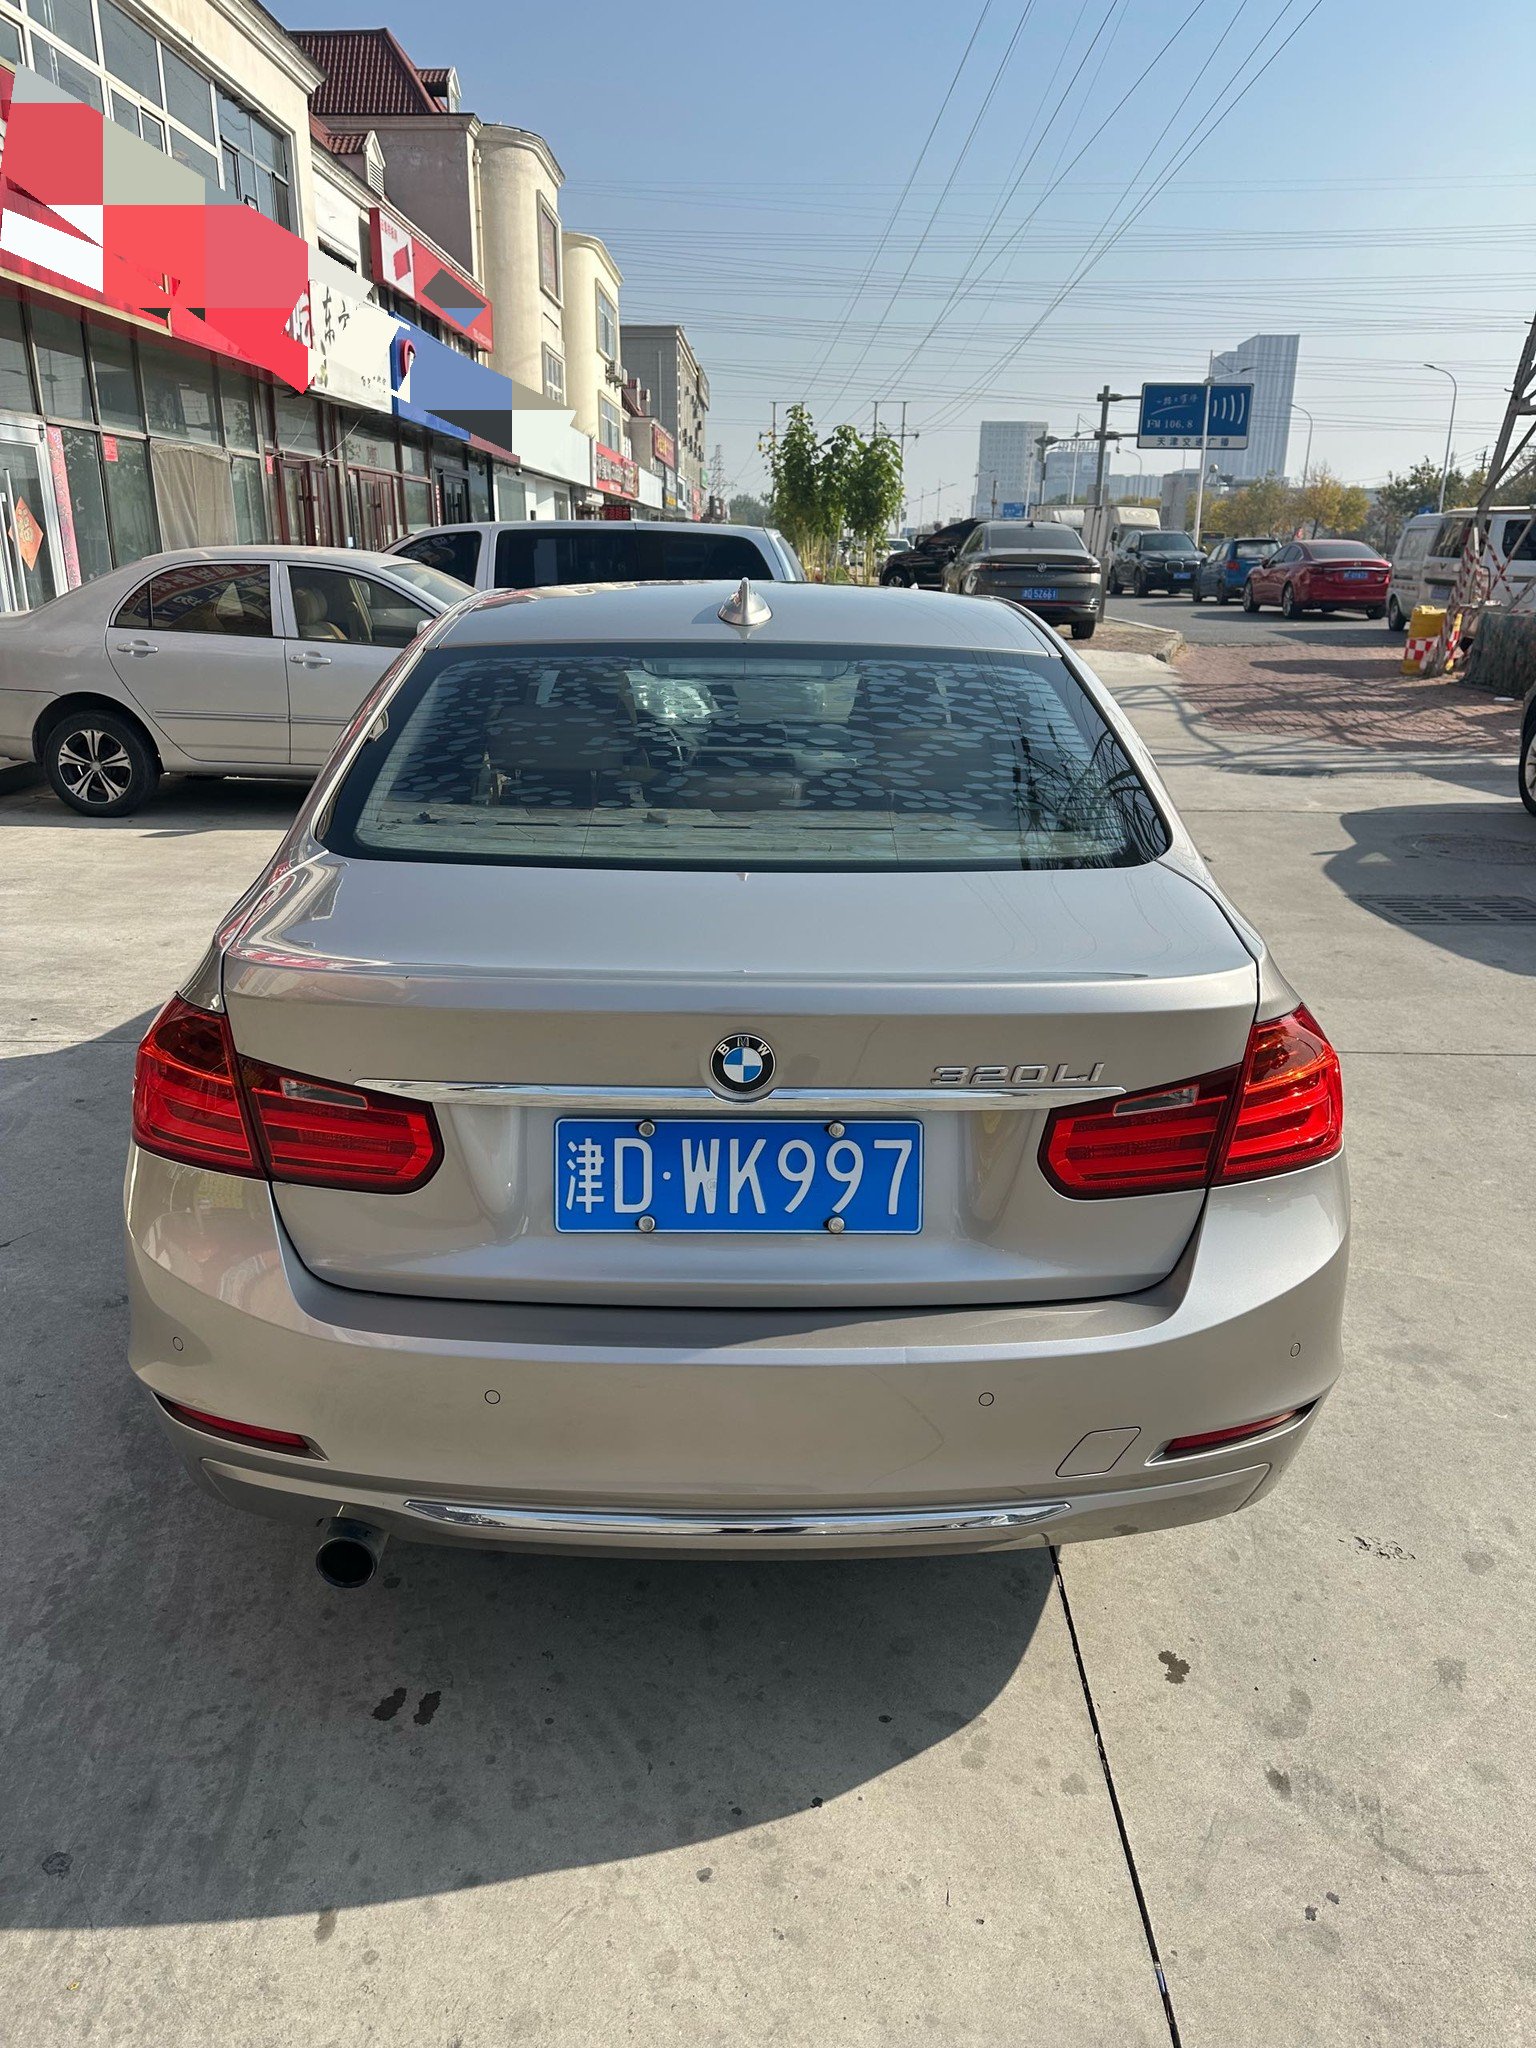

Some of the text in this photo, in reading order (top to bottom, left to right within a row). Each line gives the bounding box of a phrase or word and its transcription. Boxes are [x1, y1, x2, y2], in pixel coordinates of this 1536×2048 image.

[1146, 419, 1161, 429] FM
[717, 1036, 770, 1056] BMW
[565, 1137, 914, 1216] 津D·WK997
